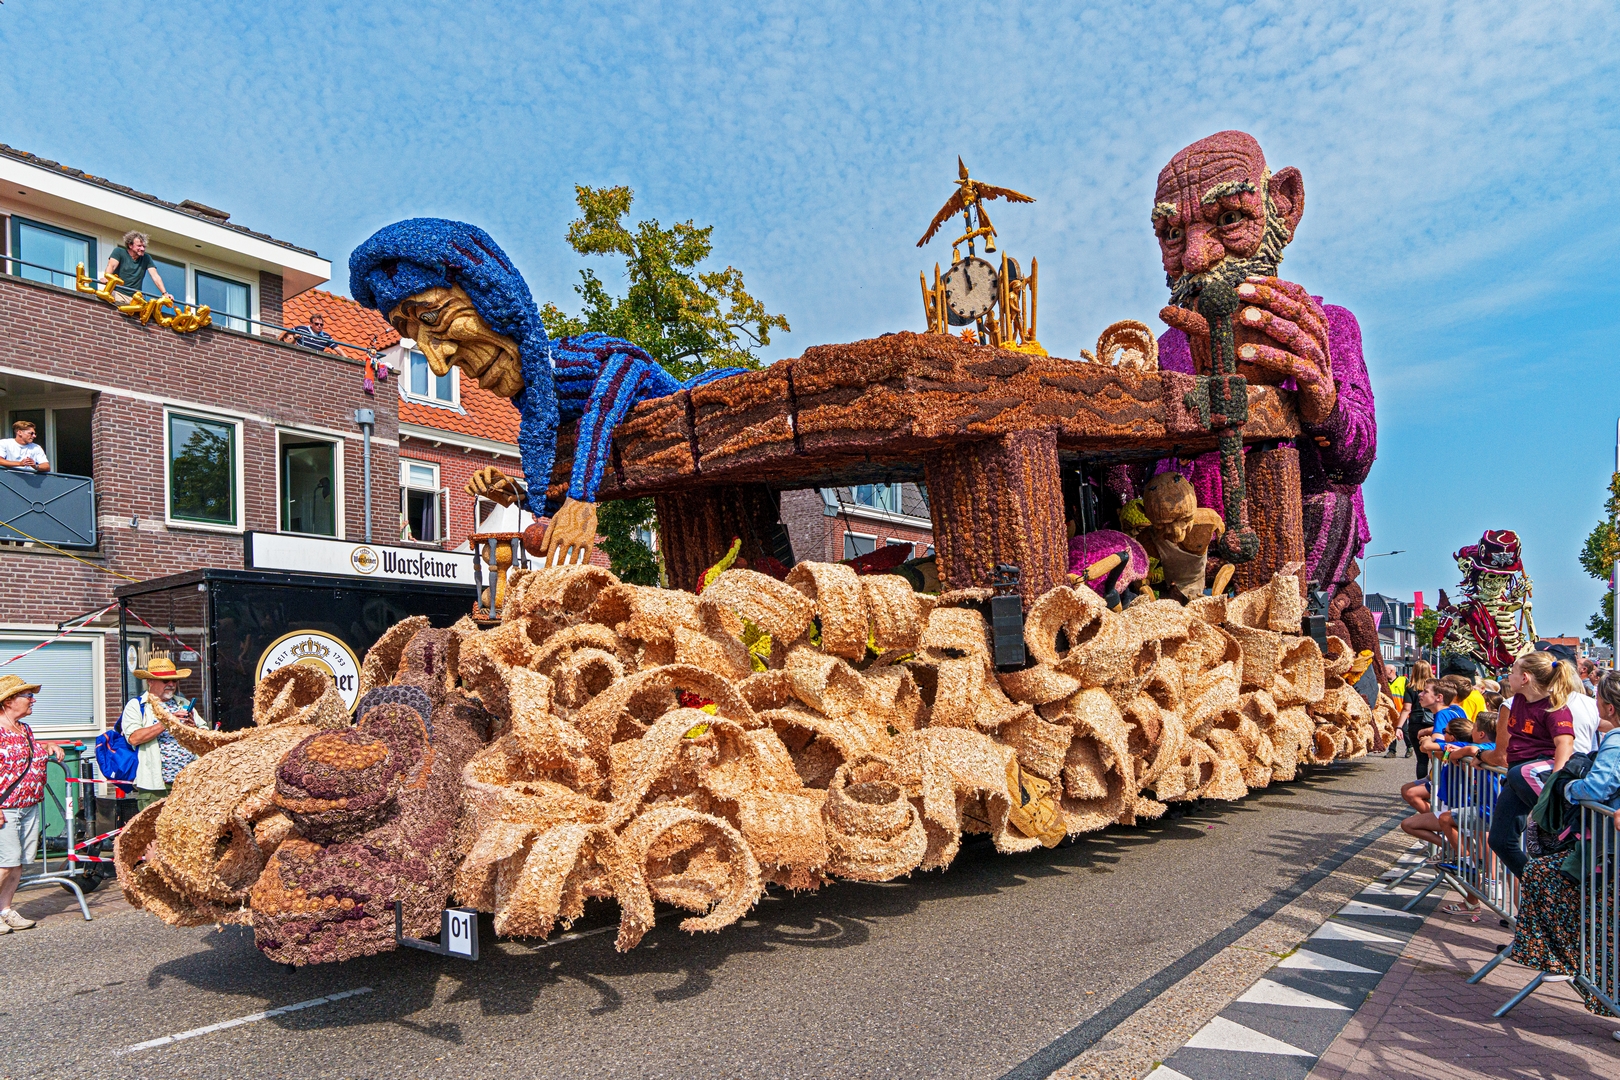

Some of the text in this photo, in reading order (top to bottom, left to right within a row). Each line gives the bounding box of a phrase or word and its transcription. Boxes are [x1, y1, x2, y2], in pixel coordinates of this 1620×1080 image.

[382, 550, 458, 579] Warsteiner
[274, 651, 346, 667] SEIT 1753
[451, 916, 469, 939] 01
